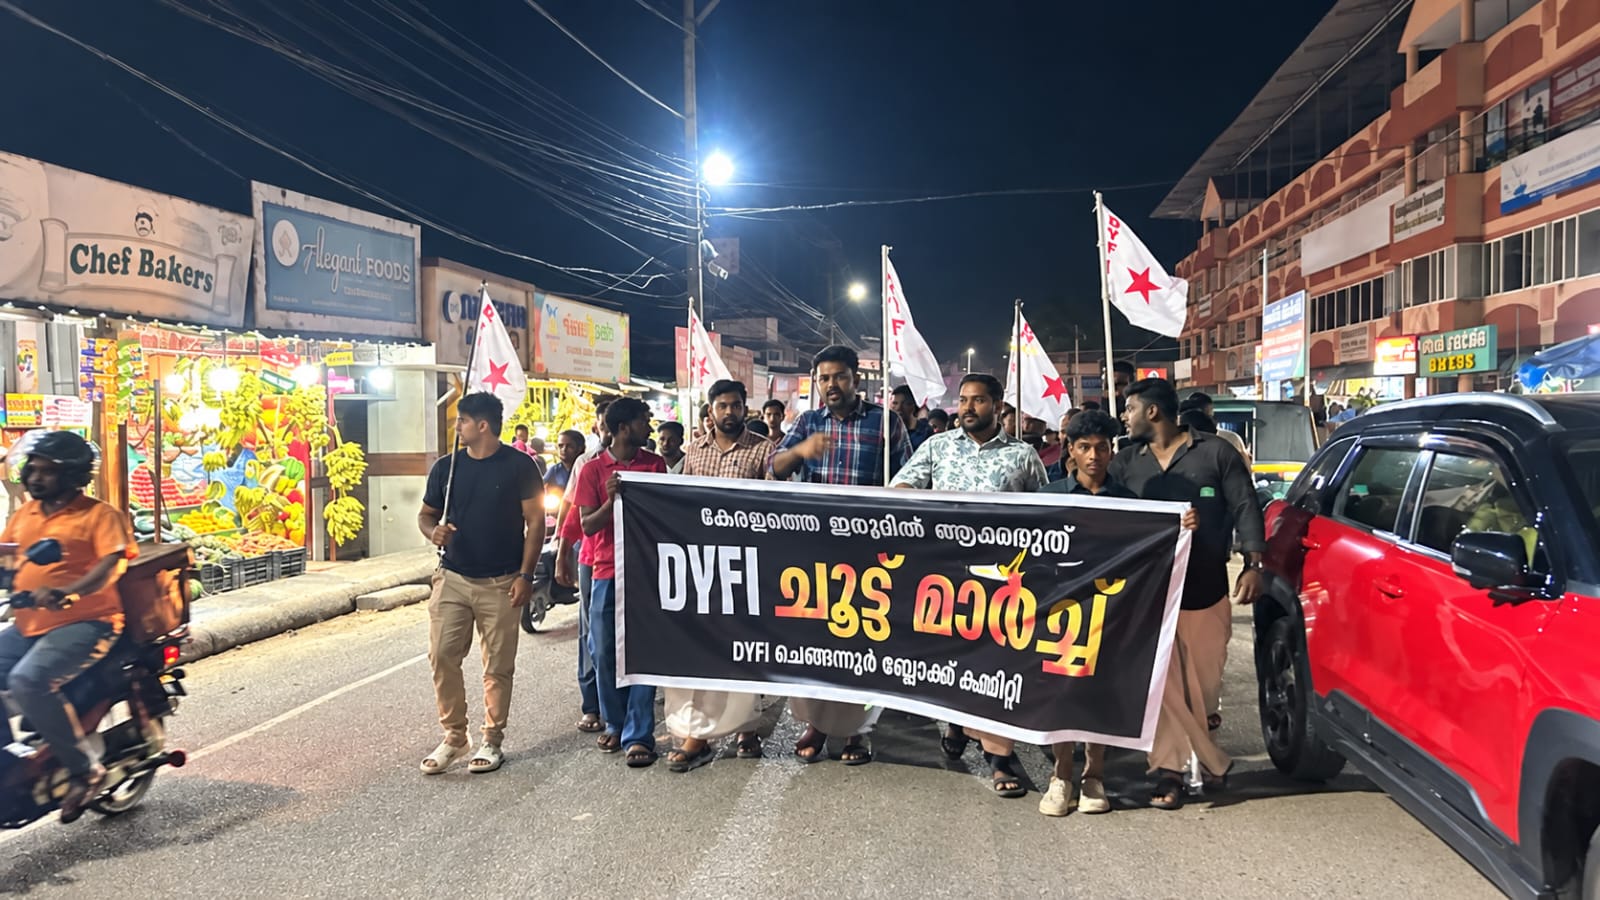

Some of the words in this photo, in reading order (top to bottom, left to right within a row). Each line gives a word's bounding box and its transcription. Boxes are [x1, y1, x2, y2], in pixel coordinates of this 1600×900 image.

[70, 243, 132, 275] Chef
[138, 248, 214, 293] Bakers
[366, 257, 411, 283] FOODS
[1107, 215, 1121, 275] DYFI
[657, 542, 760, 616] DYFI
[774, 551, 906, 642] ചൂട്ട്
[912, 569, 1128, 677] മാർച്ച്
[732, 640, 770, 663] DYFI
[959, 669, 1023, 711] കമ്മിറ്റി
